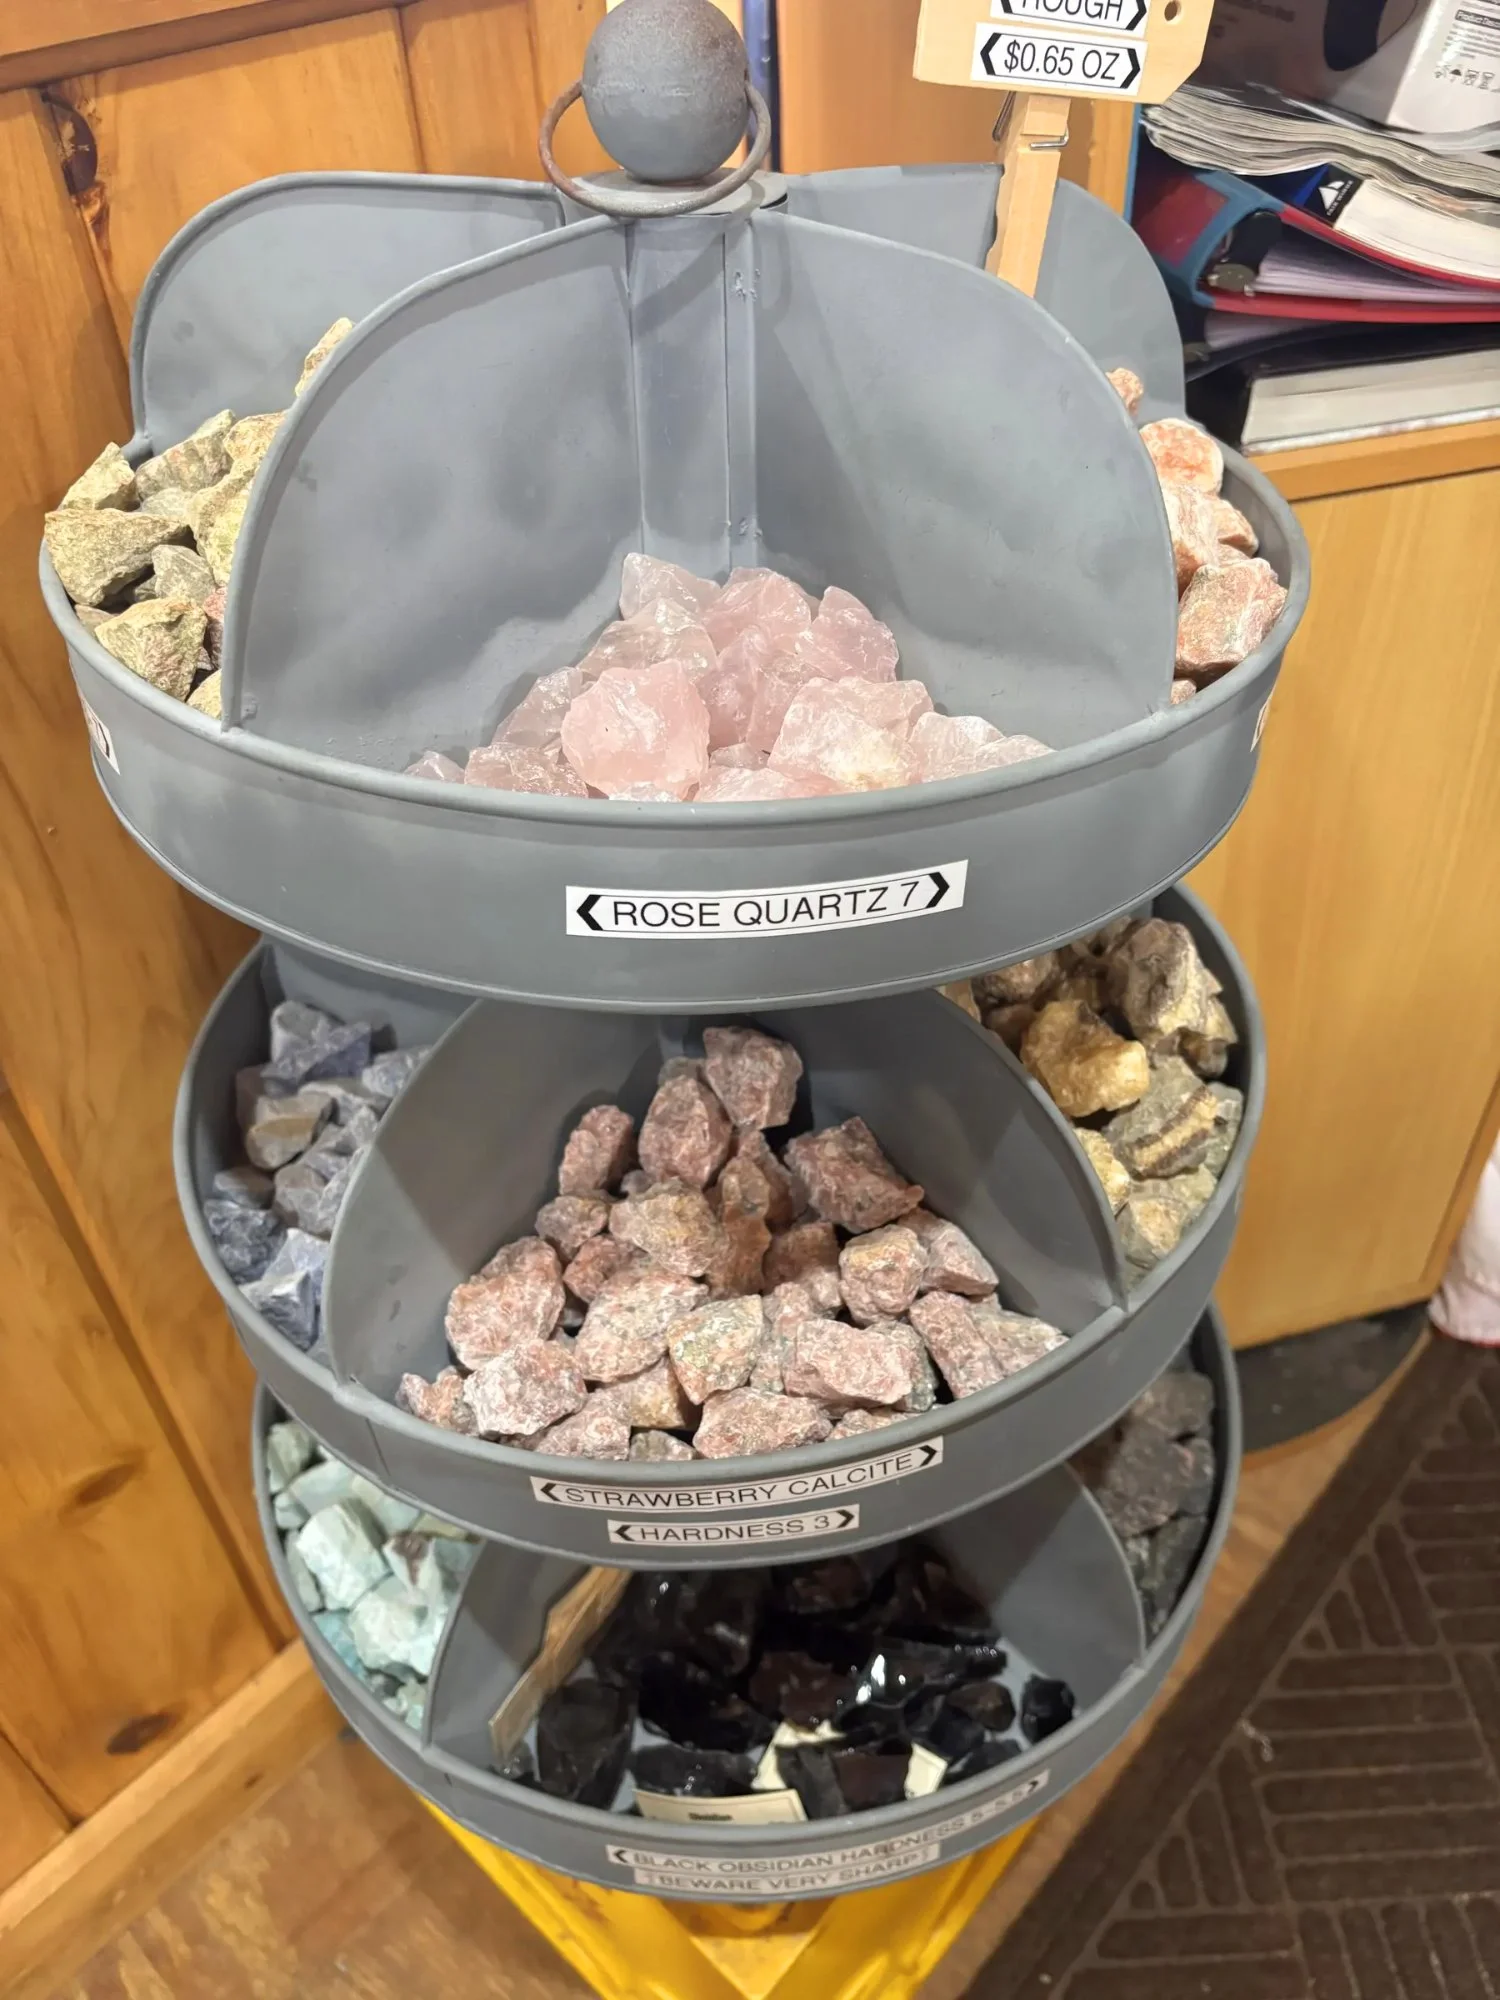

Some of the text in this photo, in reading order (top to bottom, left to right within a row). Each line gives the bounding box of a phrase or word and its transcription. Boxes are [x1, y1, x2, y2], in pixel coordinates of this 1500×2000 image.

[1004, 40, 1120, 80] $0.65 OZ
[612, 881, 920, 928] ROSE QUARTZ 7
[566, 1453, 913, 1508] STRAWBERRY CALCITE
[640, 1514, 831, 1542] HARDNESS 3
[633, 1852, 712, 1873] BLACK
[718, 1855, 834, 1874] OBSIDIAN
[659, 1875, 761, 1891] BEWARE
[768, 1871, 828, 1889] VERY
